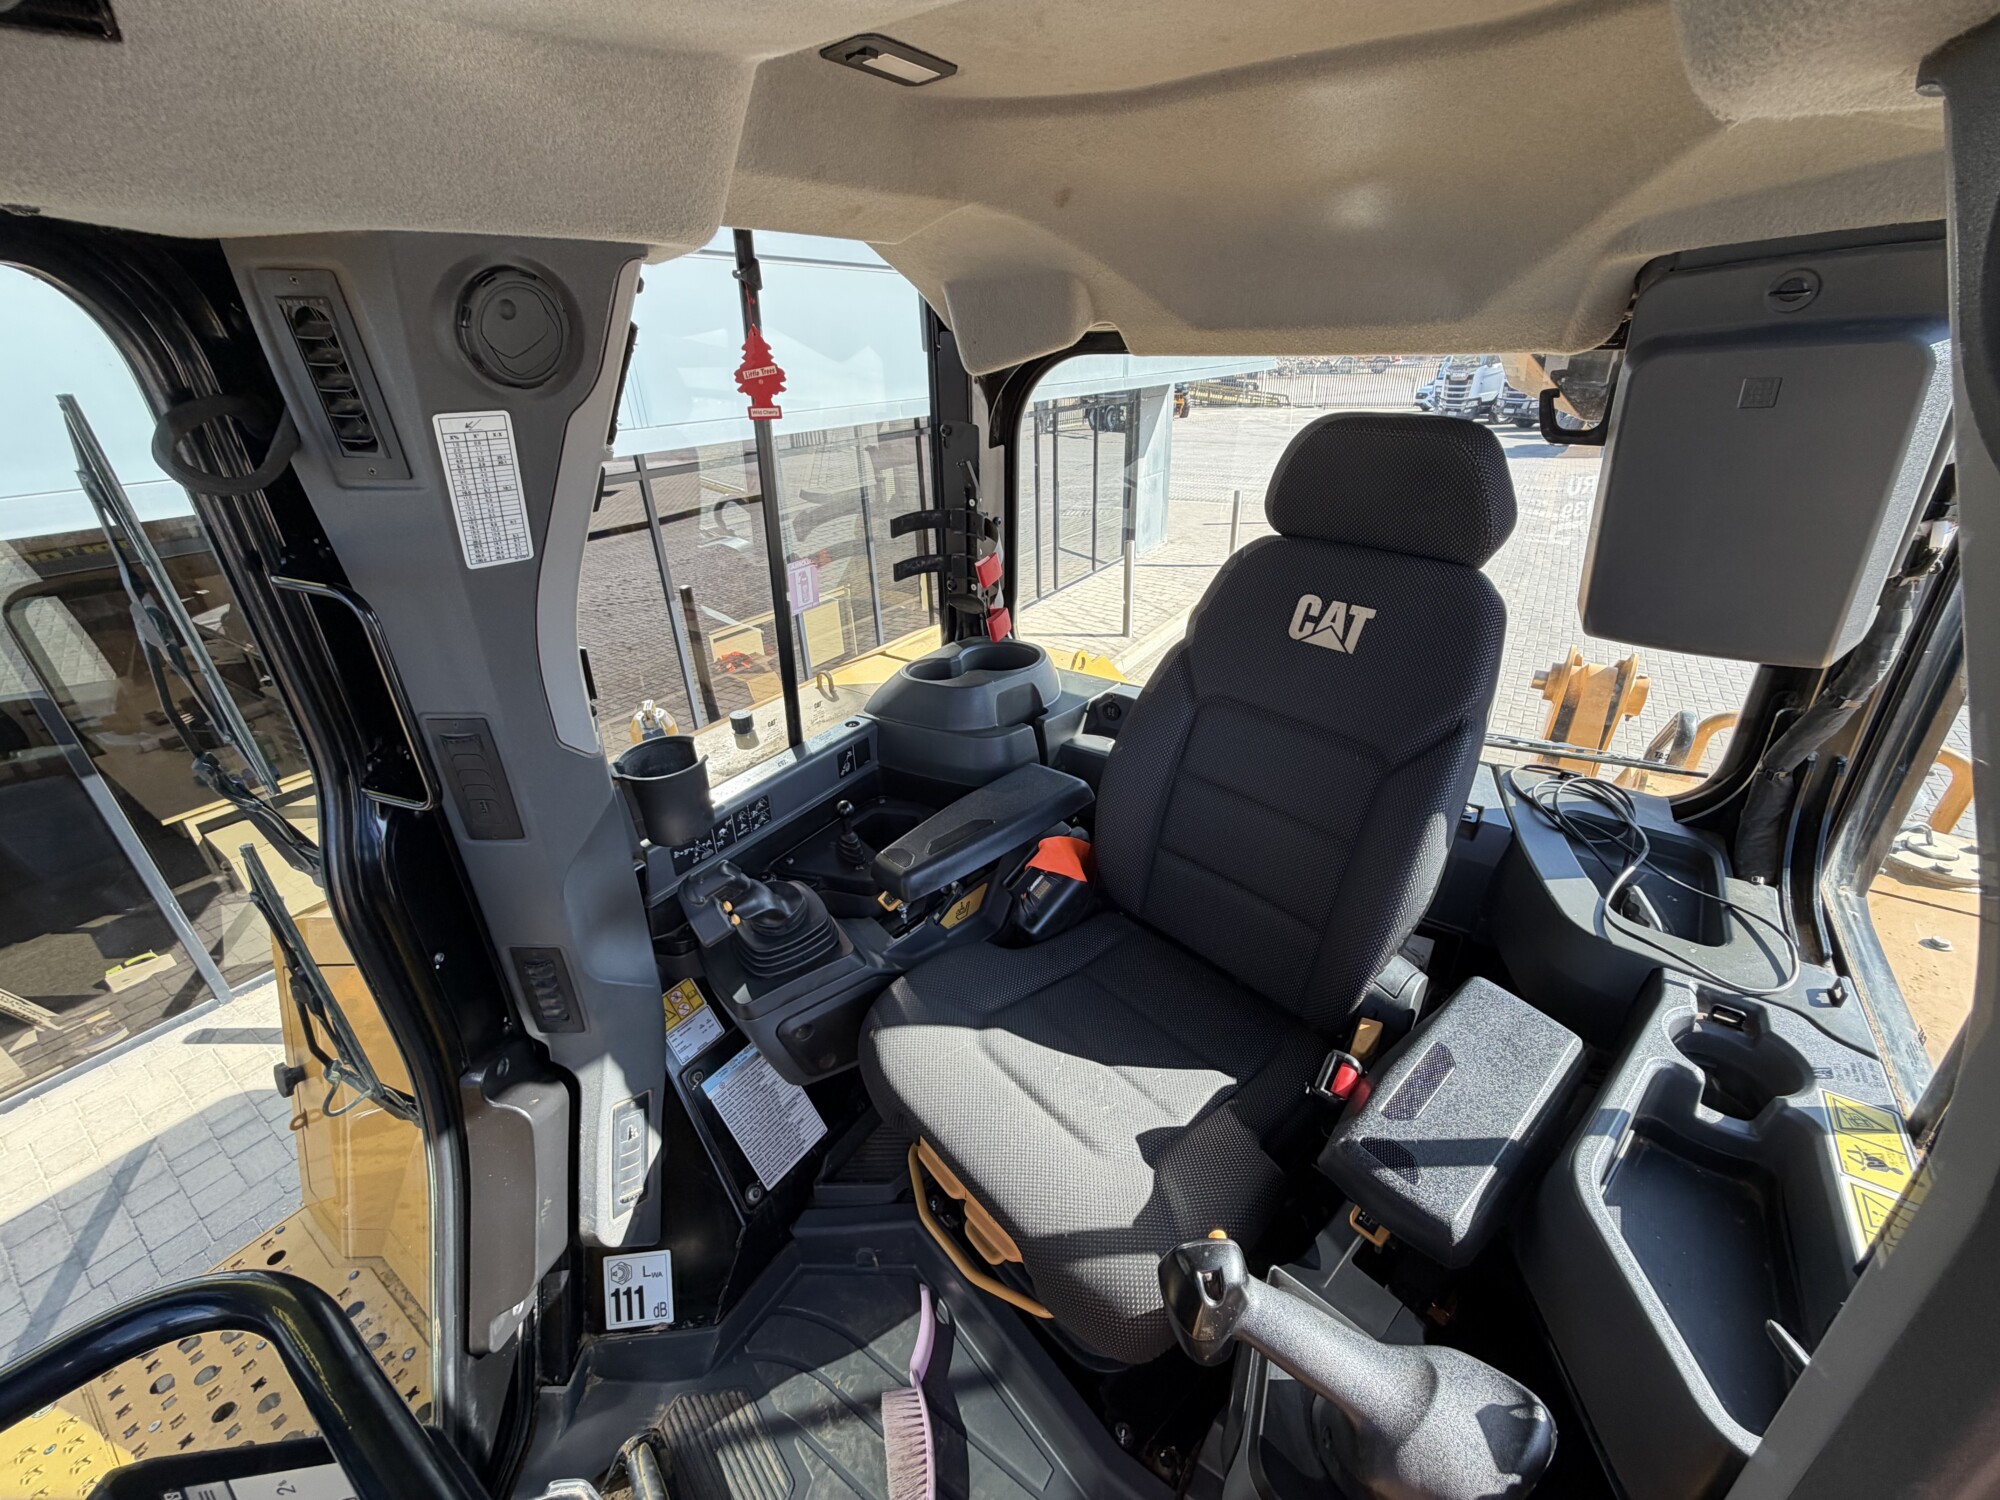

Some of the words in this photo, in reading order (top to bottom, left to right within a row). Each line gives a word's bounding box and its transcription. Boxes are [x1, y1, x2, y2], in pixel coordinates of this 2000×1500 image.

[1288, 594, 1377, 654] CAT
[610, 1285, 645, 1322] 111
[653, 1302, 668, 1318] dB
